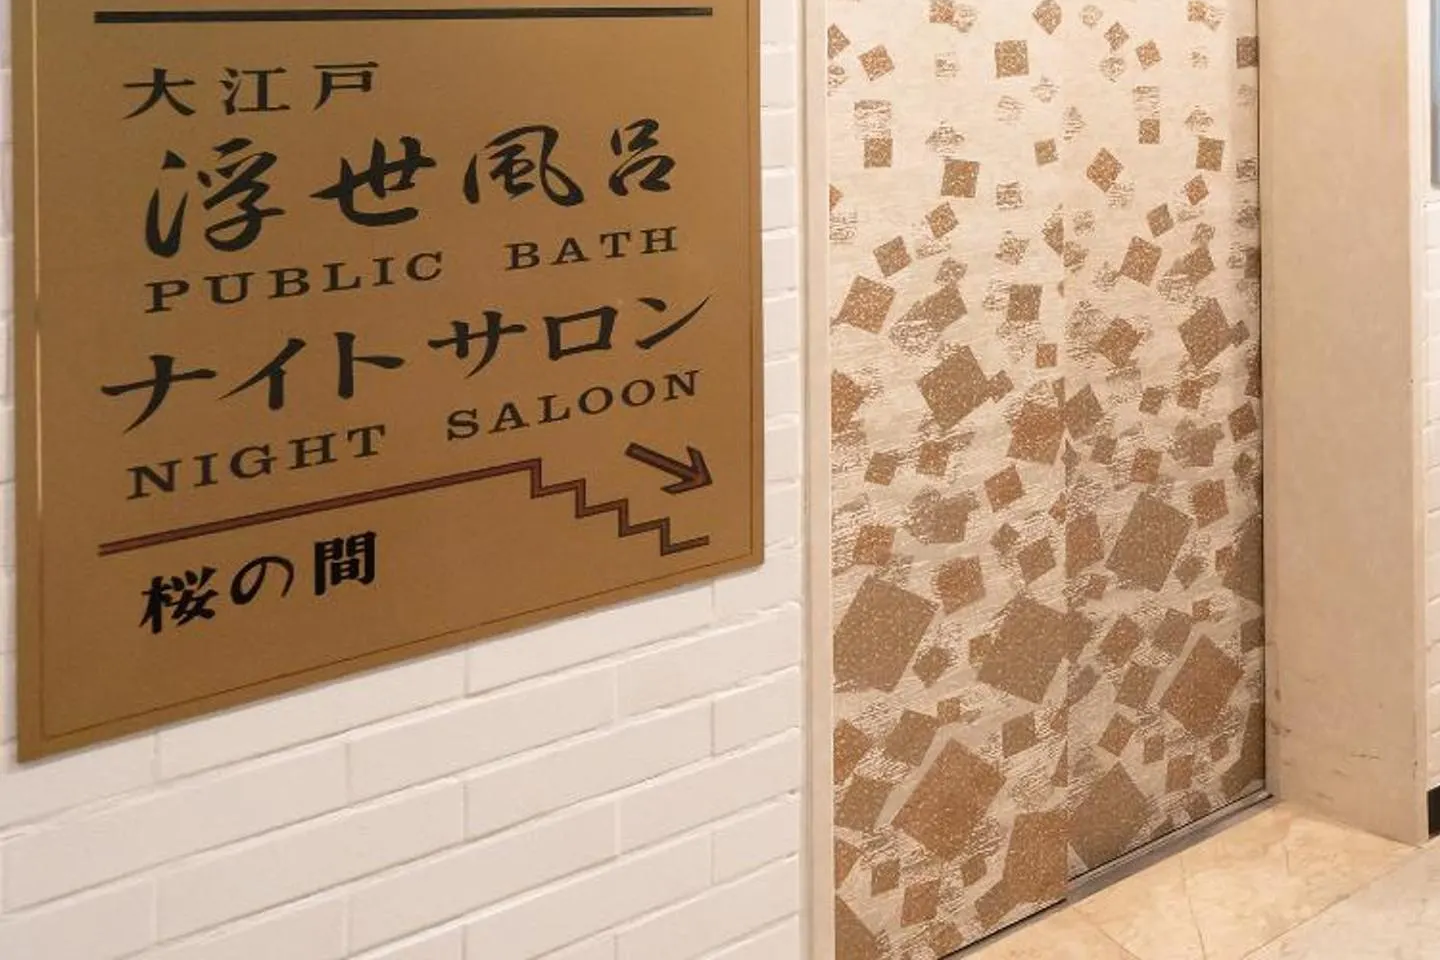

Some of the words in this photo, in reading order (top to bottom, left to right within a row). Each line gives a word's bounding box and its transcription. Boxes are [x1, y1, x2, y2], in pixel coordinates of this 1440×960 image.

[123, 61, 380, 120] 大江戸
[145, 118, 678, 259] 浮世風呂
[143, 251, 444, 314] PUBLIC
[505, 225, 679, 272] BATH
[101, 293, 711, 434] ナイトサロン
[126, 424, 387, 501] NIGHT
[446, 369, 700, 442] SALOON
[138, 530, 379, 635] 桜の間
